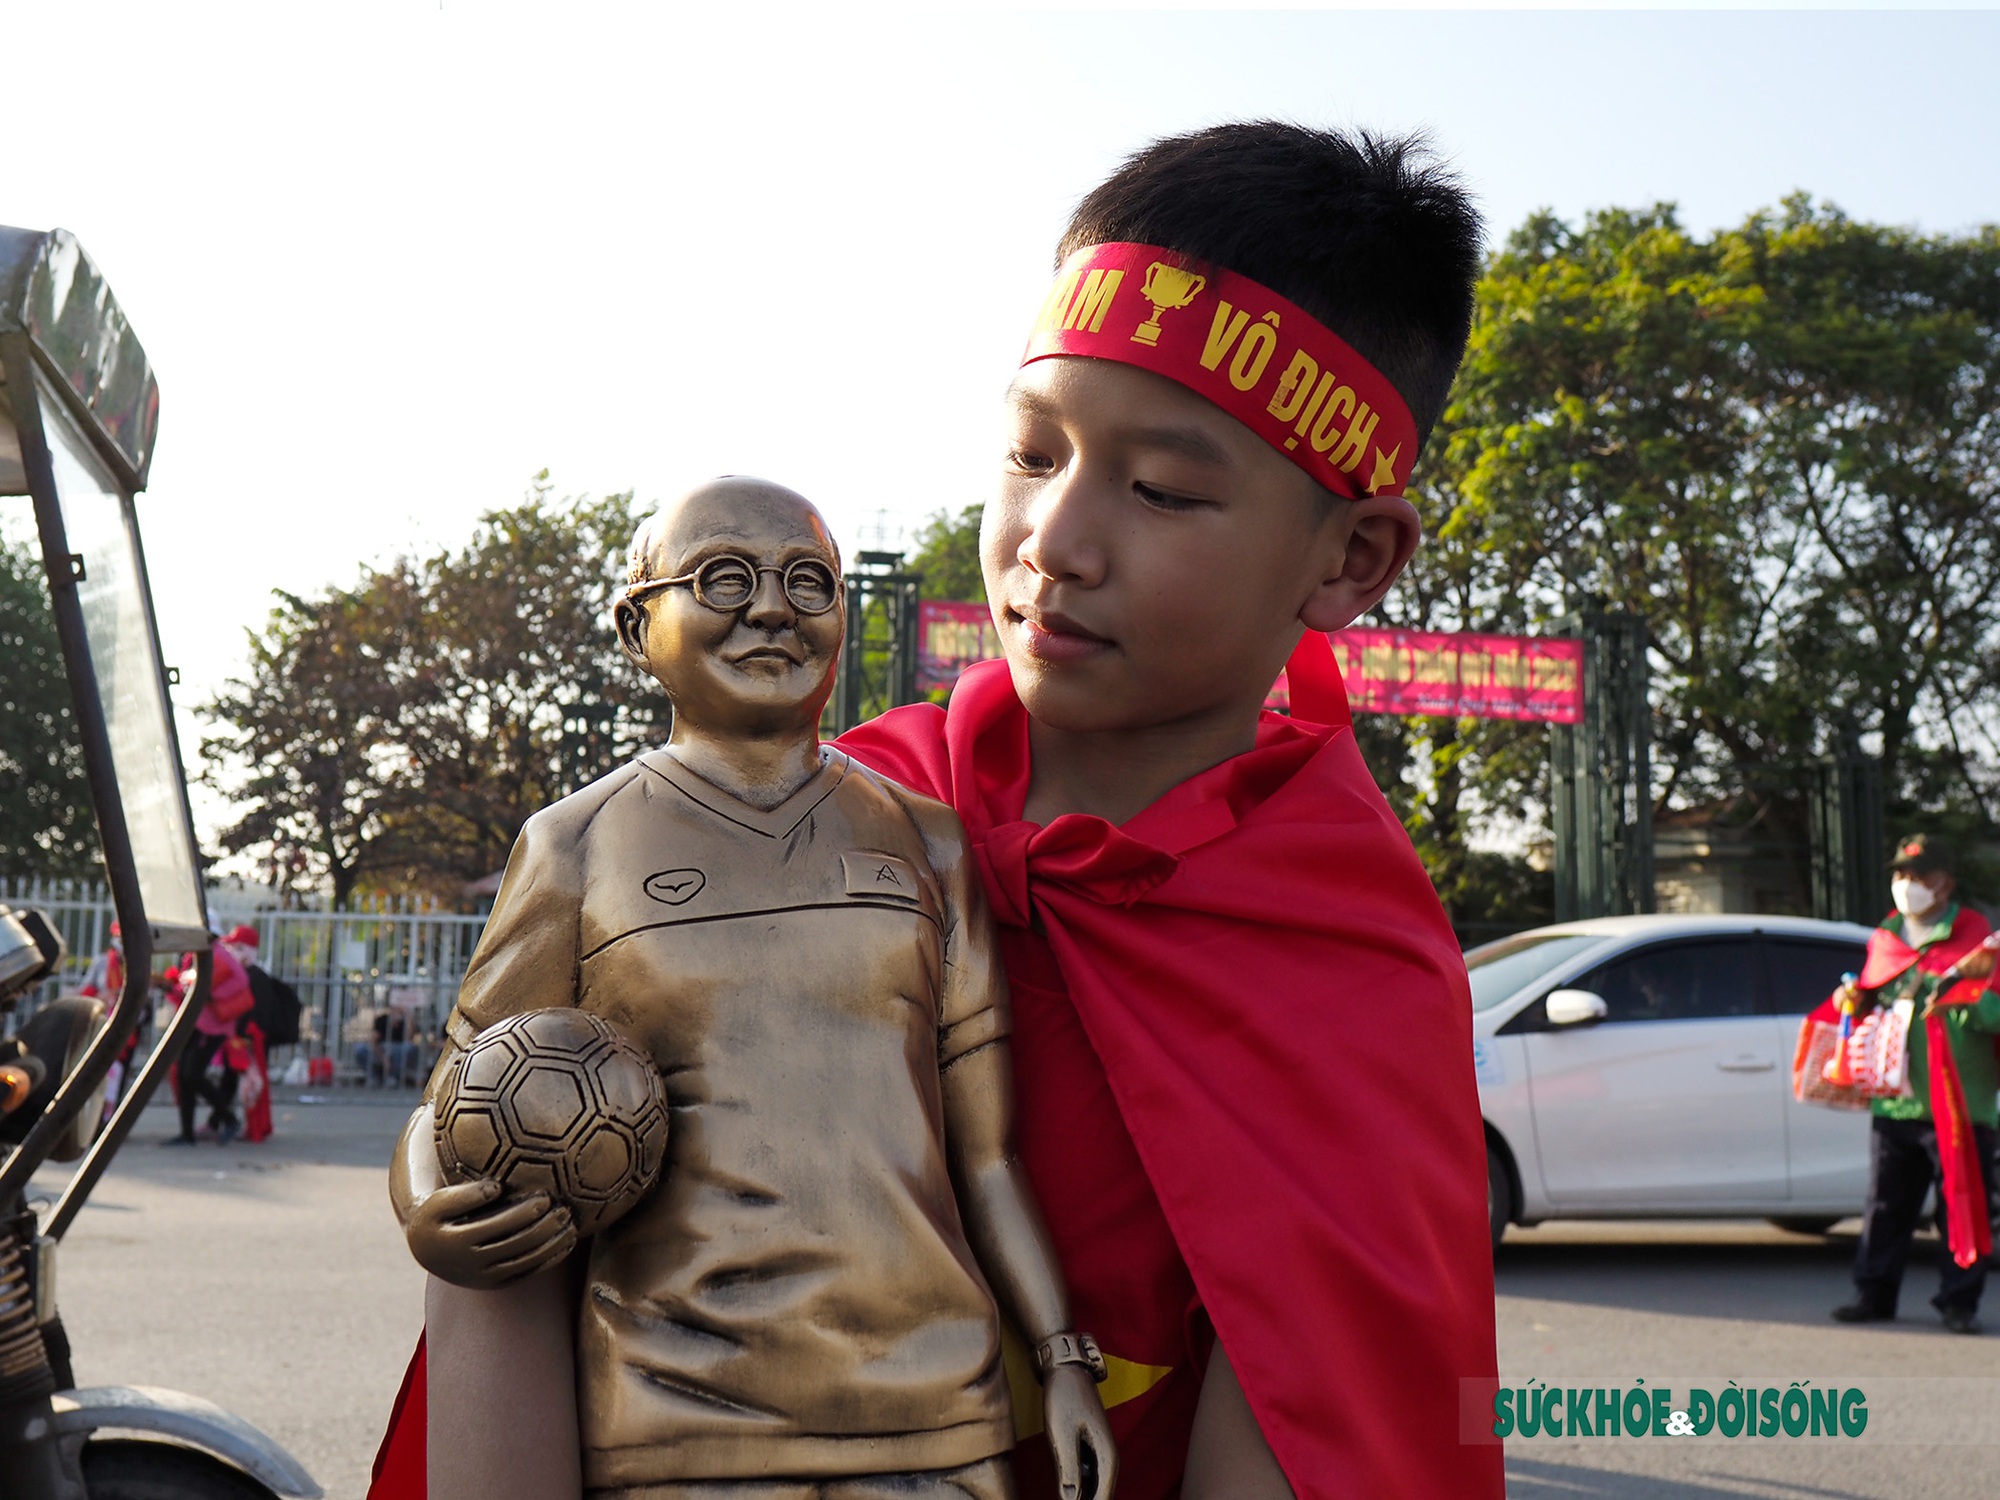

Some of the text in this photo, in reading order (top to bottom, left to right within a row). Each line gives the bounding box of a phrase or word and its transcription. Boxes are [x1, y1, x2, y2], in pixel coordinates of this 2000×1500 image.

[1036, 268, 1380, 474] AM VÔ ĐỊCH
